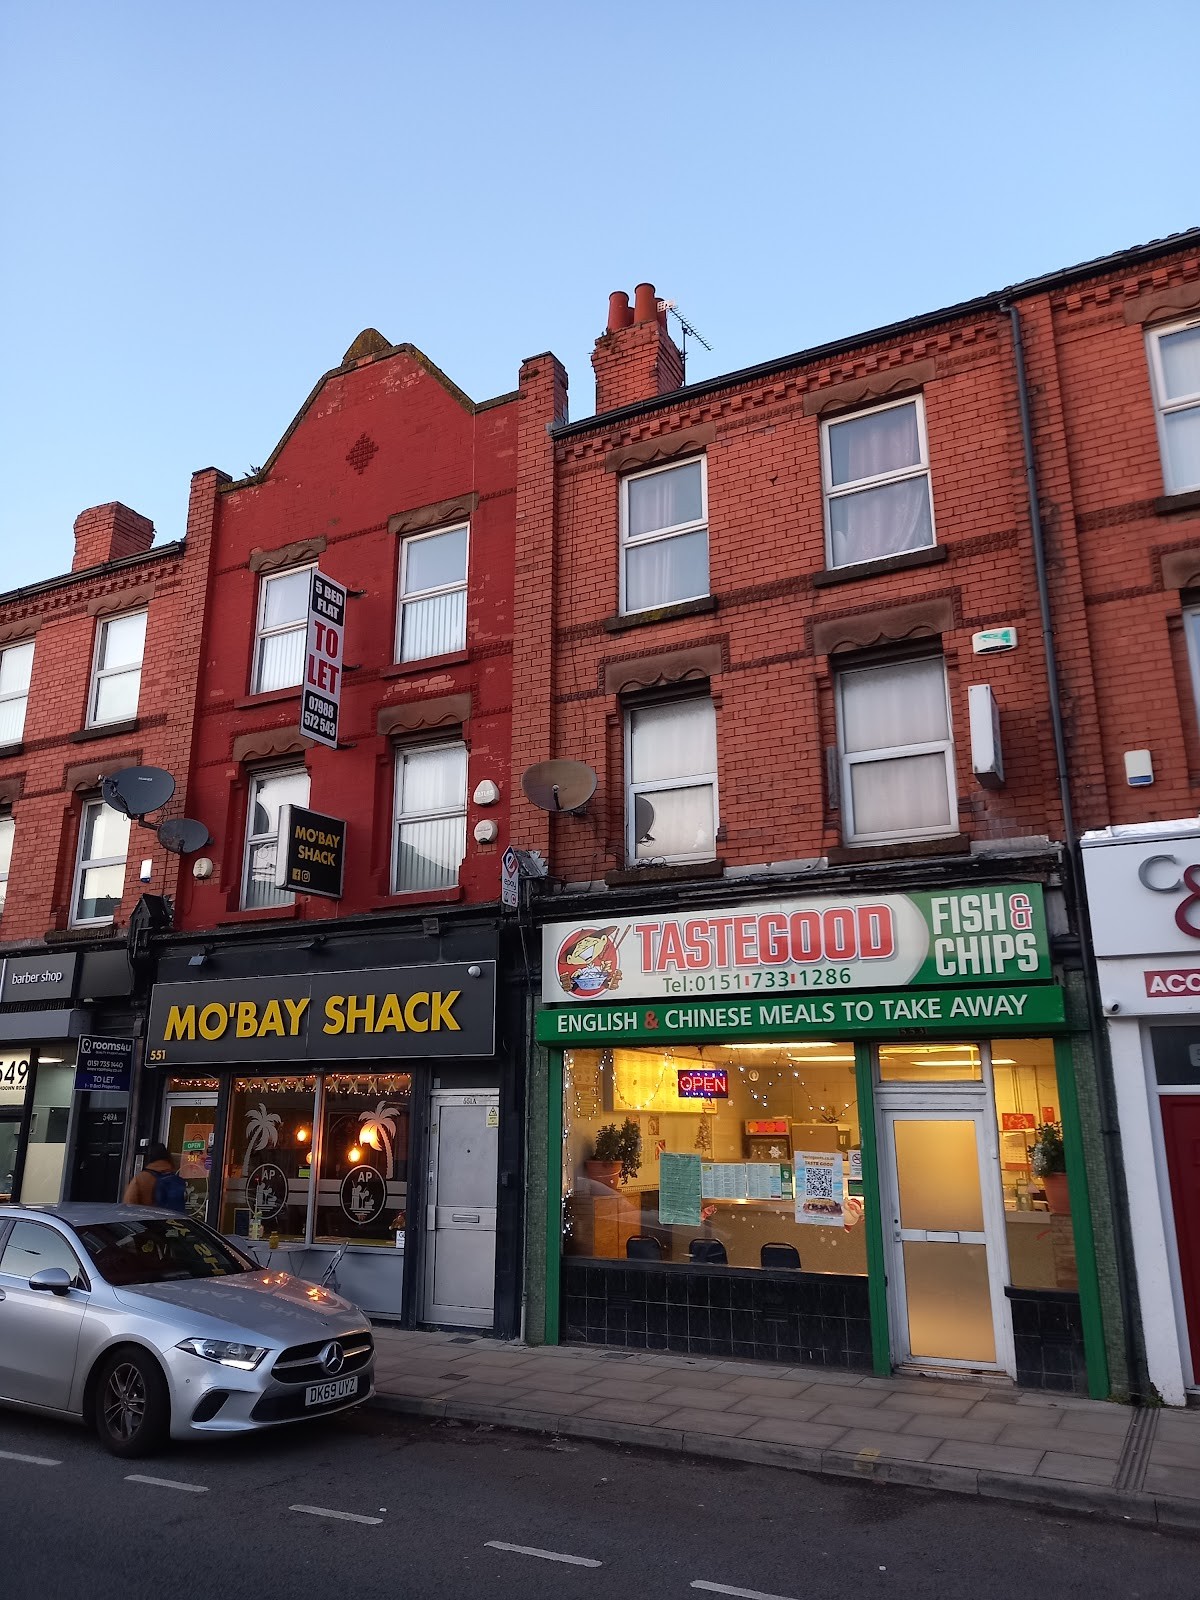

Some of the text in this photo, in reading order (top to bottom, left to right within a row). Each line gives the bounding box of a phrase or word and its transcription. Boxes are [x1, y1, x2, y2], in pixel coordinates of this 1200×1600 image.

[315, 582, 343, 607] 5 BED
[317, 599, 340, 620] FLAT
[314, 620, 338, 659] TO
[307, 654, 339, 695] LET
[308, 695, 334, 719] 07988
[304, 710, 336, 737] 572 543
[294, 825, 340, 849] MO'BAY
[298, 844, 336, 867] SHACK
[503, 878, 517, 891] epay
[1138, 854, 1181, 893] C
[930, 892, 1033, 936] FISH &
[633, 903, 896, 974] TASTEGOOD
[934, 932, 1040, 977] CHIPS
[11, 969, 63, 985] barber shop
[163, 990, 462, 1041] MO'BAY SHACK
[557, 993, 1029, 1033] ENGLISH & CHINESE MEALS TO TAKE AWAY
[92, 1041, 132, 1052] rooms4u
[150, 1050, 166, 1061] 551
[93, 1075, 115, 1084] TO LET
[679, 1076, 726, 1092] OPEN
[102, 1113, 117, 1121] 549A
[262, 1169, 276, 1181] AP
[357, 1171, 373, 1183] AP
[310, 1378, 355, 1402] DK69 UYZ
